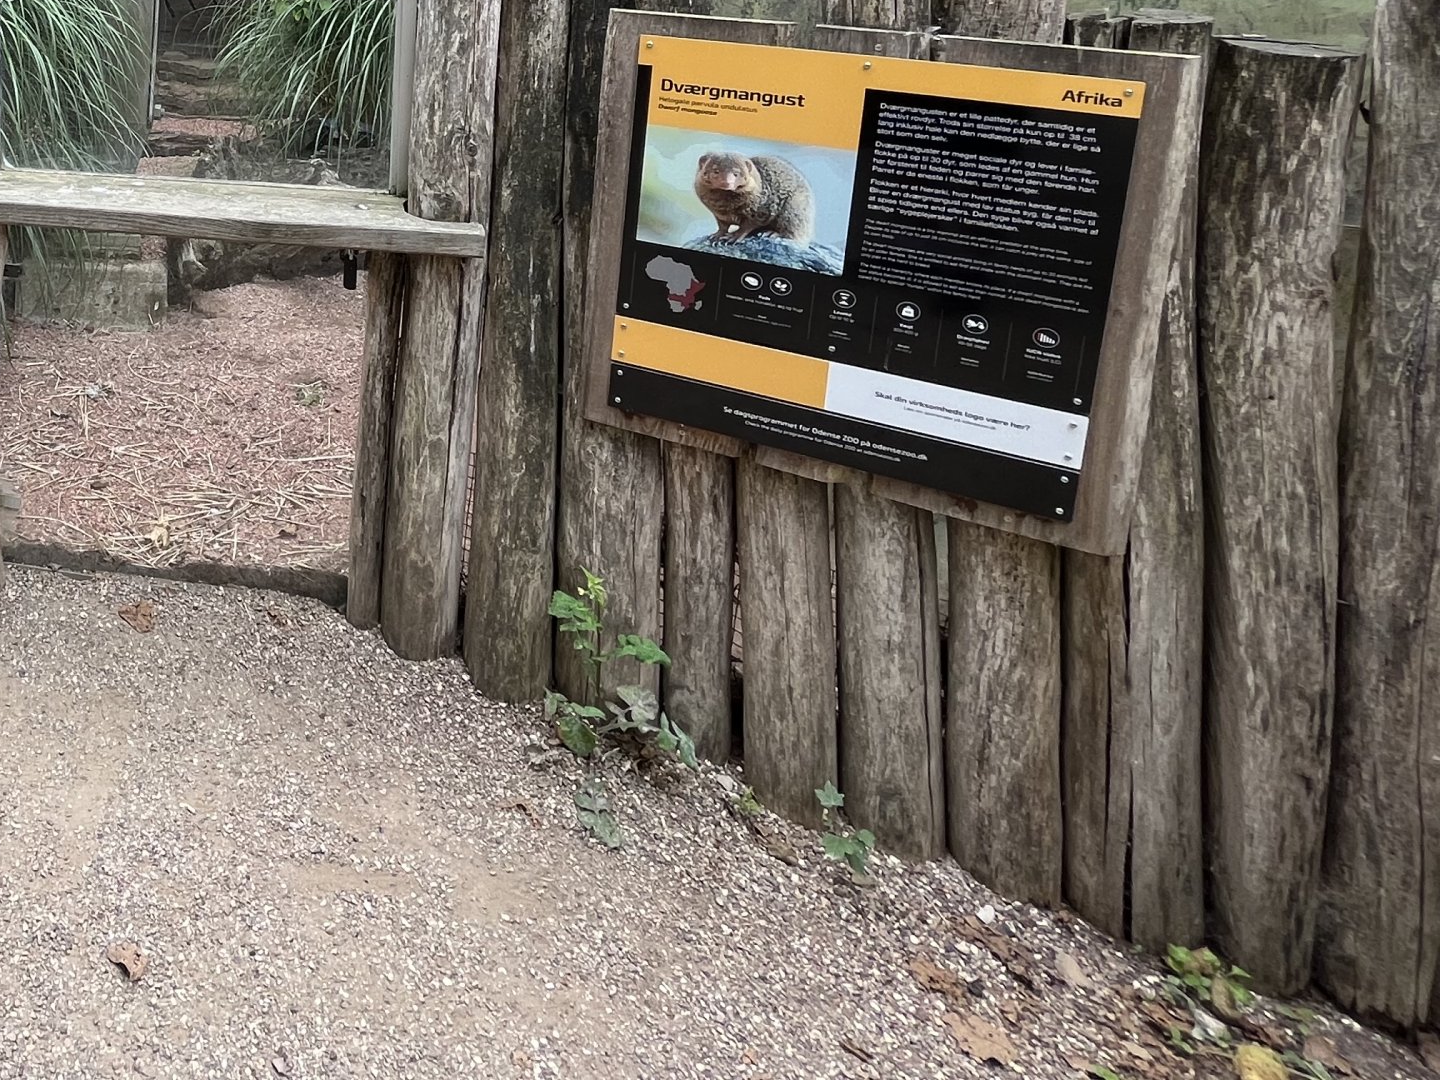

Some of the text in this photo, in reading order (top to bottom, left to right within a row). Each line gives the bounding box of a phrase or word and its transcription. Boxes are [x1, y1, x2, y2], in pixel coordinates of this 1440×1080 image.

[661, 79, 806, 107] Dværgmangust
[1061, 90, 1123, 107] Afrika
[875, 392, 892, 400] Skal
[909, 401, 963, 416] virksomheds
[965, 412, 984, 421] logo
[986, 418, 1009, 426] være
[1010, 422, 1030, 430] her?
[724, 406, 733, 414] Se
[734, 410, 798, 429] dagsprogrammet
[812, 428, 841, 440] Odense
[842, 435, 860, 444] ZOO
[872, 443, 928, 461] odensezoo.dk
